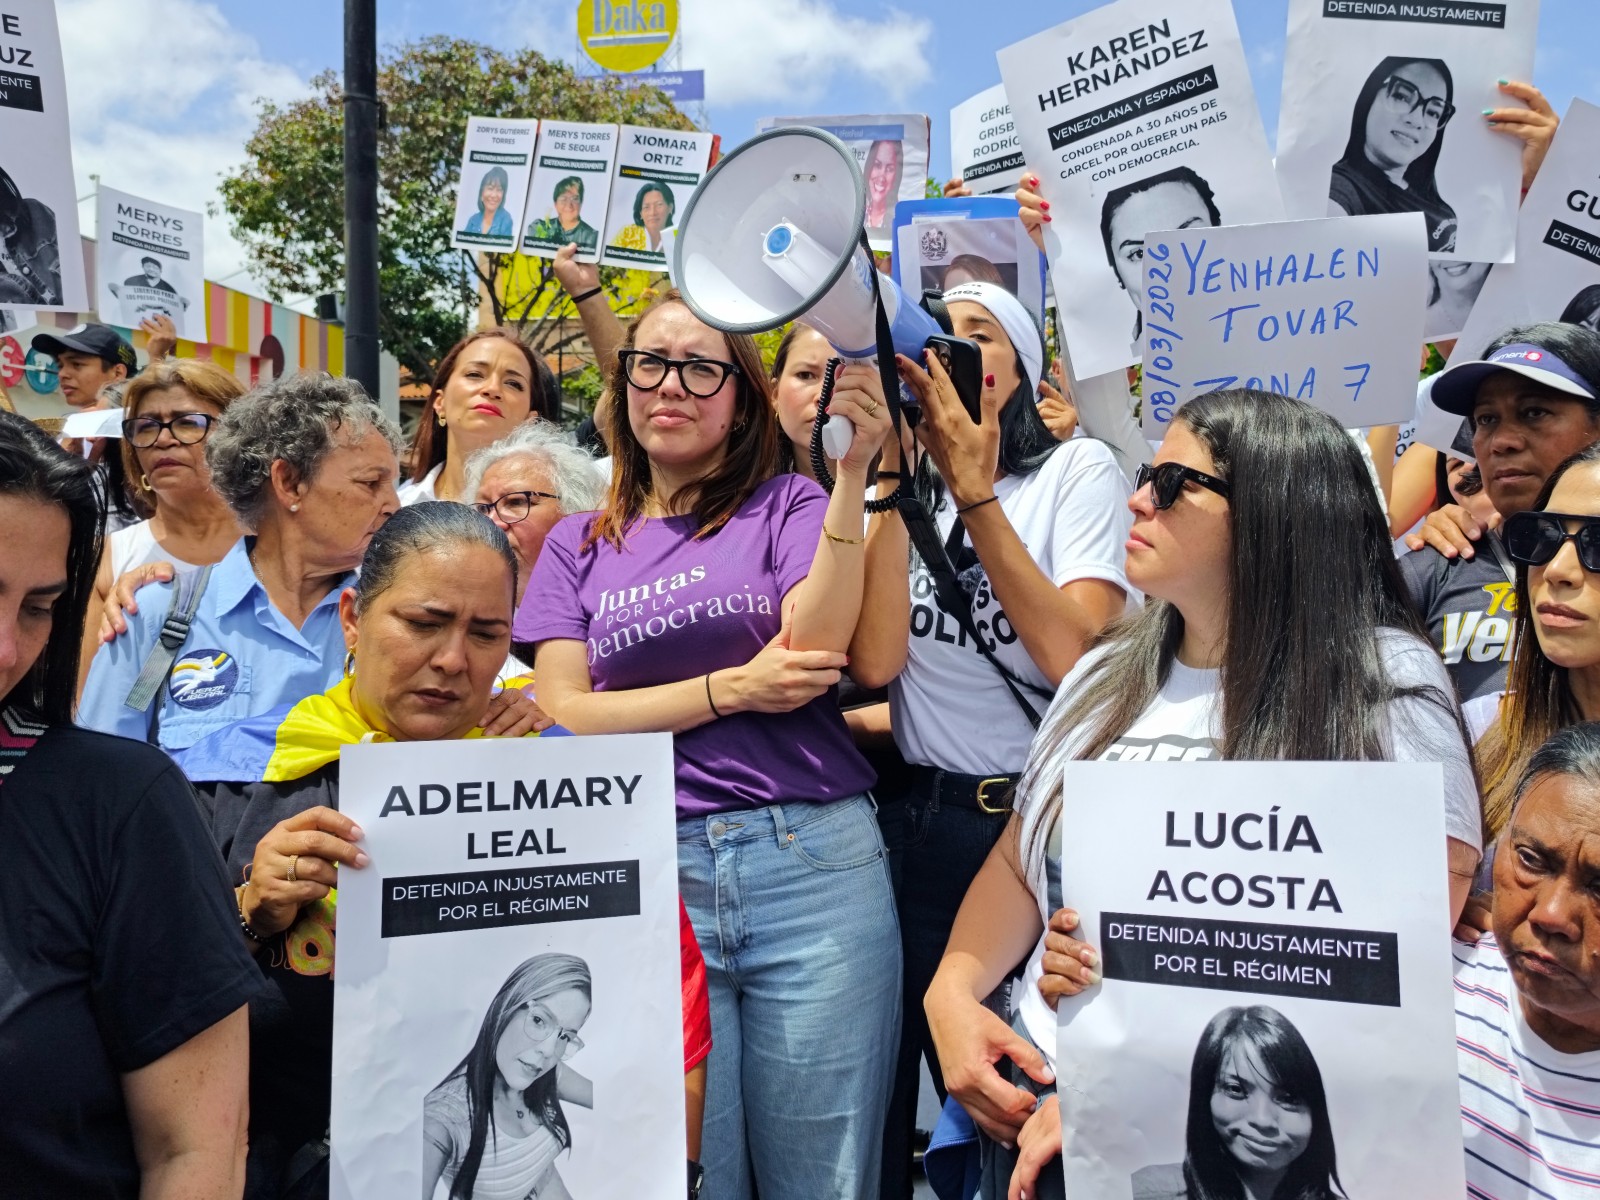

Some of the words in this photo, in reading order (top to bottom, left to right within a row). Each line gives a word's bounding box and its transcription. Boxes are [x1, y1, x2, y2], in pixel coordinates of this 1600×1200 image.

[593, 0, 666, 34] Daka
[1327, 1, 1397, 15] DETENIDA
[1400, 5, 1501, 22] INJUSTAMENTE
[1067, 18, 1172, 76] KAREN
[1038, 29, 1208, 112] HERNÁNDEZ
[1052, 104, 1133, 141] VENEZOLANA
[1133, 99, 1142, 109] Y
[1145, 73, 1213, 106] ESPAÑOLA
[476, 126, 499, 135] ZORYS
[548, 129, 578, 139] MERYS
[581, 132, 611, 141] TORRES
[554, 142, 566, 150] DE
[568, 144, 601, 153] SEQUEA
[633, 134, 697, 151] XIOMARA
[1060, 157, 1102, 179] CARCEL
[1104, 147, 1128, 162] POR
[1130, 128, 1178, 152] QUERER
[1180, 121, 1198, 135] UN
[1201, 111, 1228, 128] PAÍS
[1061, 130, 1133, 163] CONDENADA
[1135, 125, 1144, 135] A
[1146, 119, 1162, 131] 30
[1164, 106, 1198, 125] AÑOS
[1200, 98, 1218, 112] DE
[643, 152, 684, 166] ORTIZ
[964, 162, 1002, 179] DETENIDA
[1091, 166, 1117, 182] CON
[1118, 139, 1200, 173] DEMOCRACIA.
[117, 203, 184, 232] MERYS
[117, 220, 183, 247] TORRES
[114, 234, 143, 249] DETENIDA
[143, 243, 188, 259] INJUSTAMENTE
[1180, 239, 1379, 296] YENHALEN
[1145, 243, 1184, 423] 08/03/2026
[1208, 300, 1358, 343] TOVAR
[1343, 362, 1371, 402] 7
[594, 565, 706, 621] Juntas
[606, 603, 644, 630] POR
[652, 594, 675, 611] LA
[379, 775, 643, 818] ADELMARY
[467, 827, 567, 860] LEAL
[1165, 805, 1323, 854] LUCÍA
[393, 880, 489, 901] DETENIDA
[494, 869, 627, 892] INJUSTAMENTE
[1146, 869, 1343, 914] ACOSTA
[438, 905, 477, 921] POR
[483, 902, 504, 917] EL
[509, 895, 589, 915] RÉGIMEN
[1109, 922, 1209, 946] DETENIDA
[1215, 930, 1381, 960] INJUSTAMENTE
[1154, 954, 1197, 974] POR
[1203, 958, 1228, 977] EL
[1233, 958, 1332, 986] RÉGIMEN
